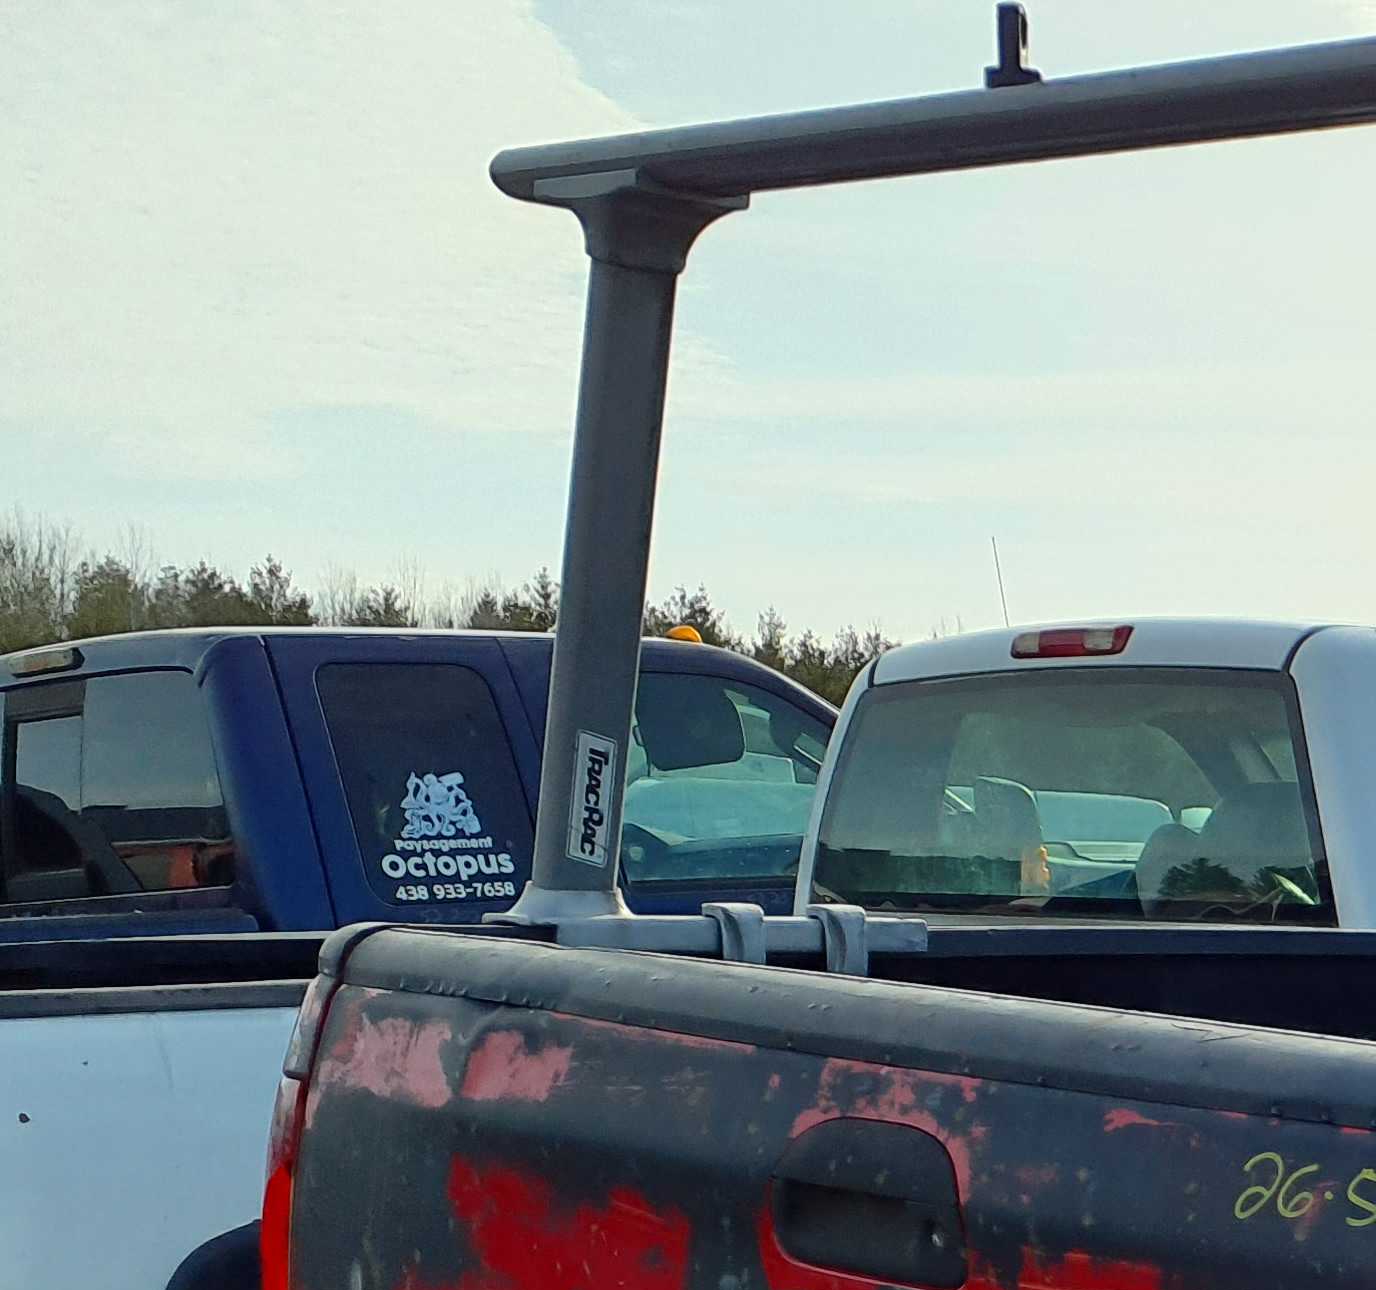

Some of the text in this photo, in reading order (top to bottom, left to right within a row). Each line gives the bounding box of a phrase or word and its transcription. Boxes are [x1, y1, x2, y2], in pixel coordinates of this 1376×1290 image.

[393, 836, 493, 852] Paysagement
[381, 851, 515, 880] Octopus
[395, 881, 516, 901] 438 933-7658
